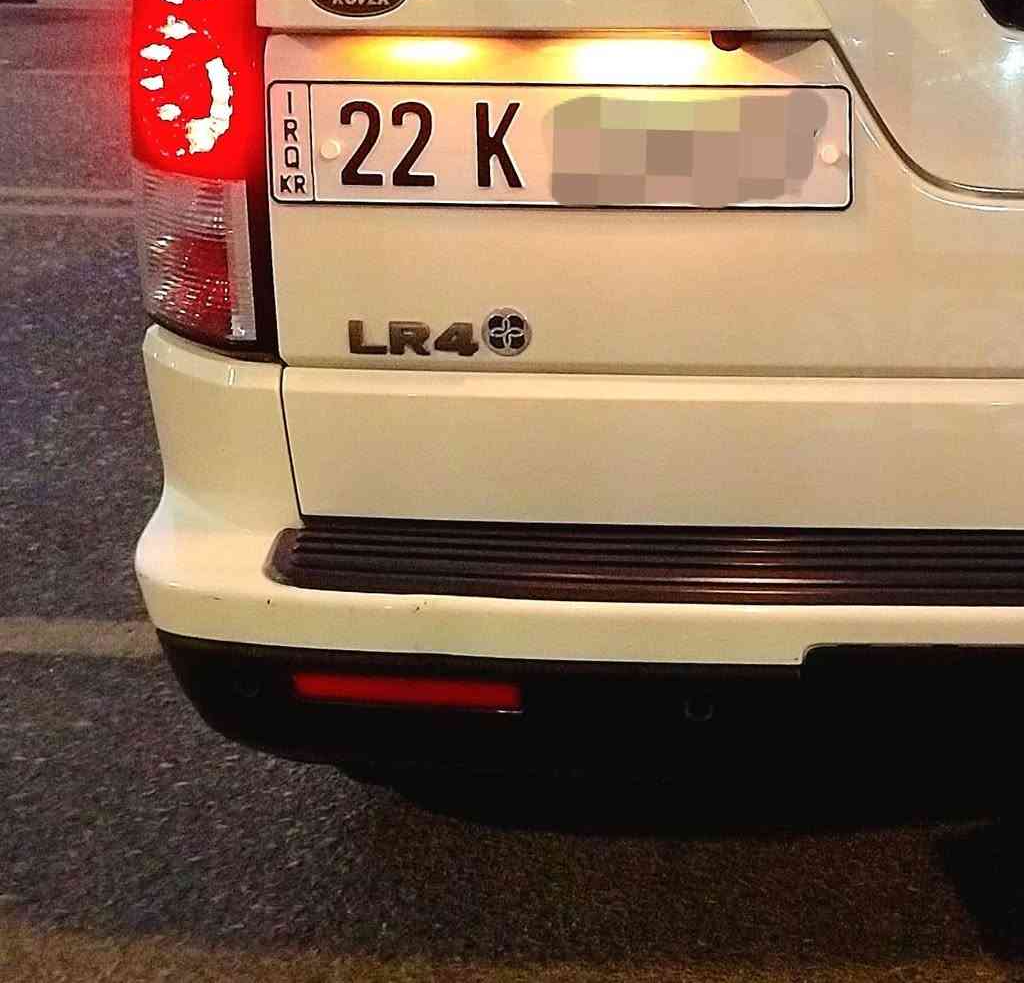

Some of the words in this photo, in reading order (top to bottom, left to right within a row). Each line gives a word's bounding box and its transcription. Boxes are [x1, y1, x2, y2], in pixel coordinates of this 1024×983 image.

[339, 101, 435, 187] 22
[475, 102, 524, 188] K
[280, 175, 306, 194] KR
[348, 320, 479, 356] LR4
